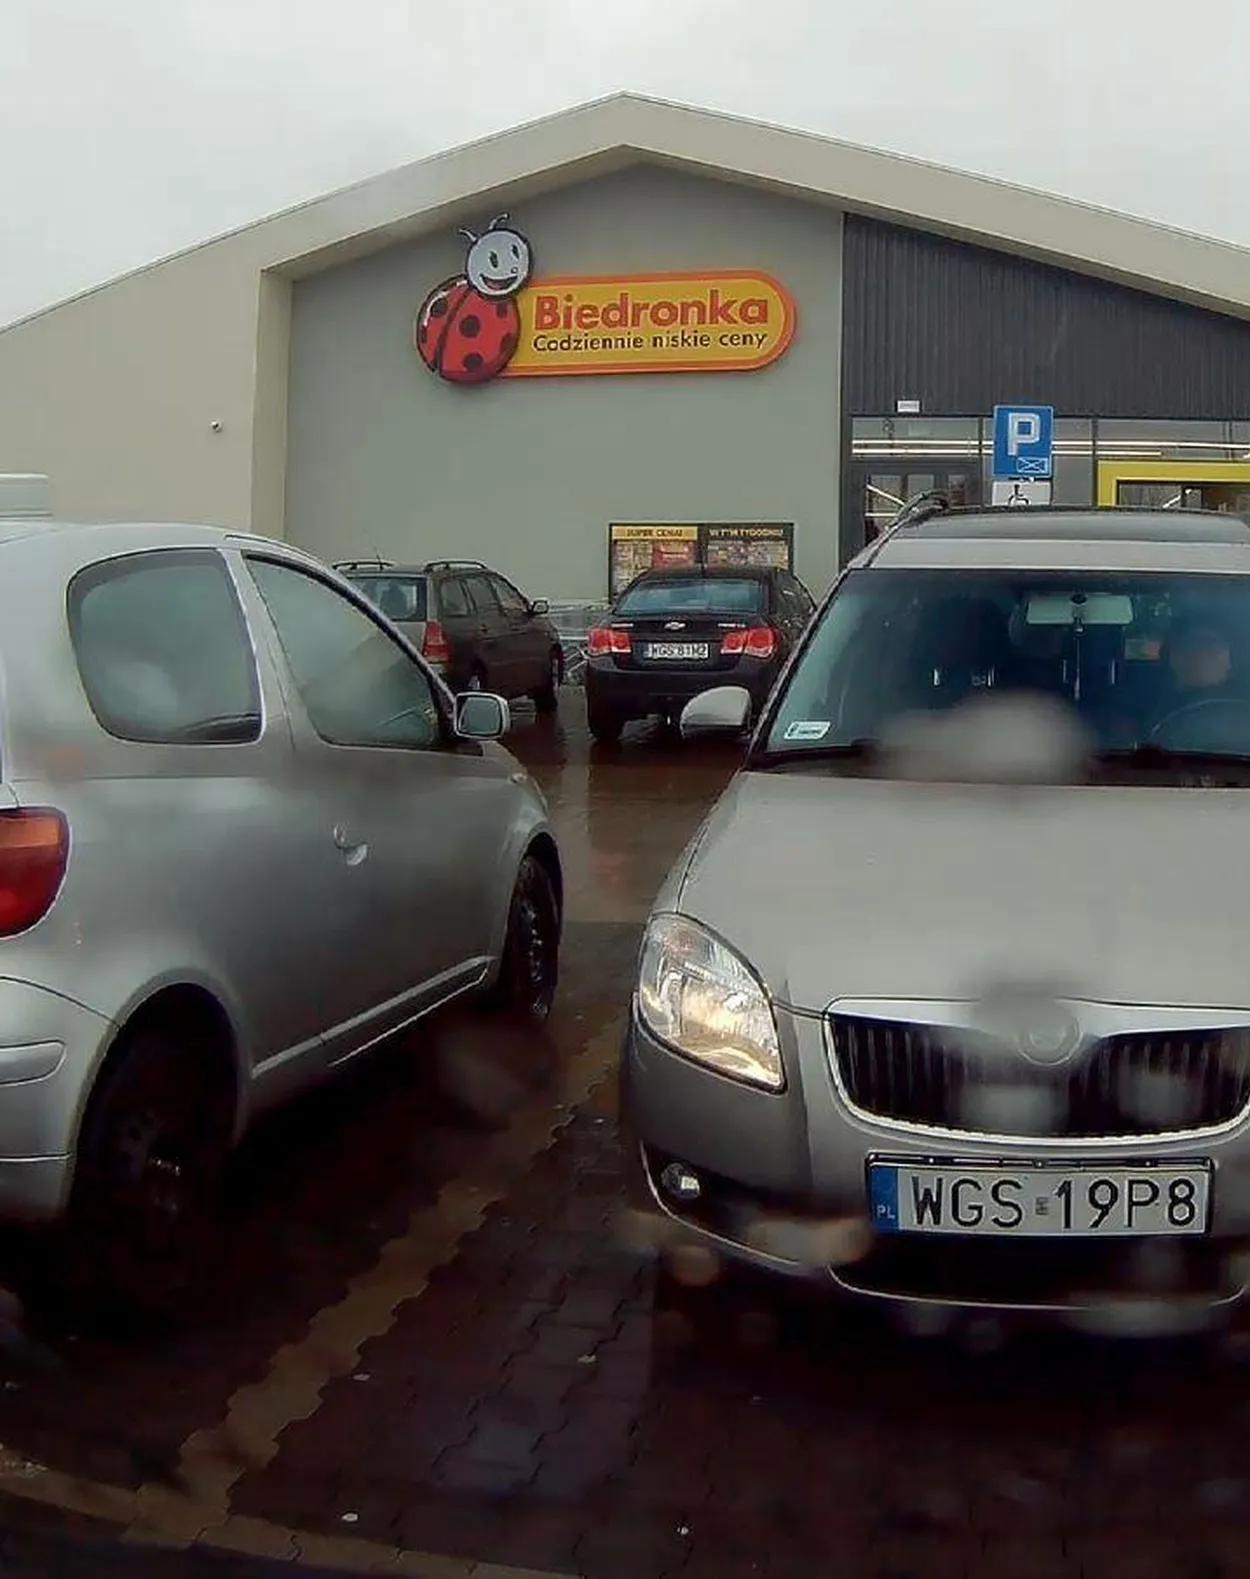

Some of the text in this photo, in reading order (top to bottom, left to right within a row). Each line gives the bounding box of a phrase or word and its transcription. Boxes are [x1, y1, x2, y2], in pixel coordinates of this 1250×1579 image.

[534, 288, 769, 330] Biedronka
[533, 330, 768, 352] Codziennie niskie ceny
[1007, 412, 1041, 456] P
[876, 1206, 896, 1220] PL
[911, 1175, 1197, 1229] WGS 19P8
